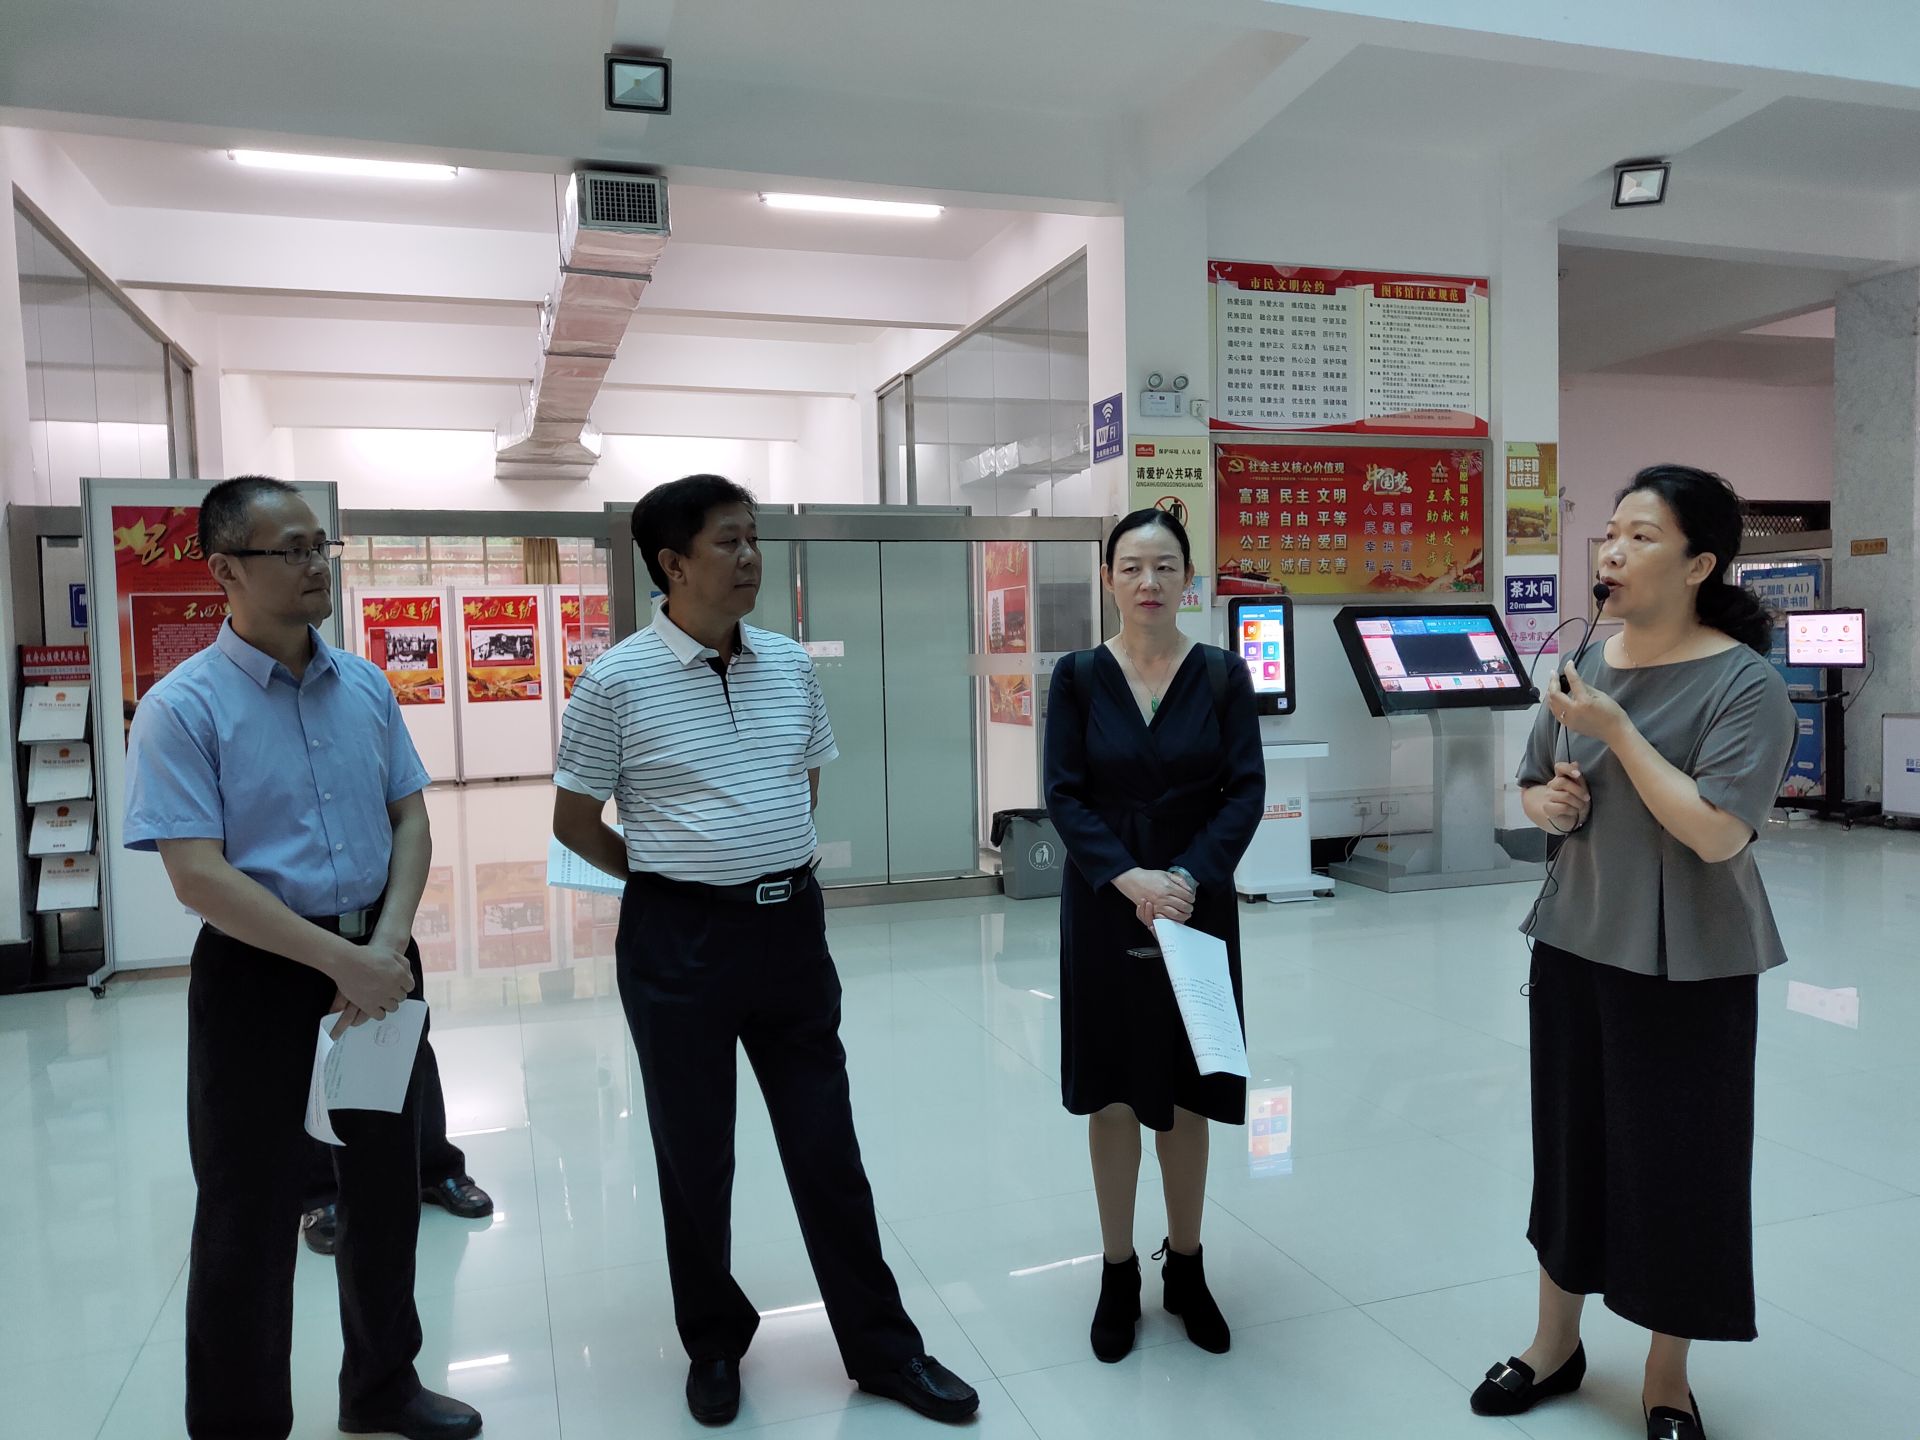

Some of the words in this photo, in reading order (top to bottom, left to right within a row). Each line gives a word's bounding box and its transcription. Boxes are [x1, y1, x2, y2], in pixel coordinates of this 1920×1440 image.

[1250, 277, 1325, 293] 市民文明公约
[1381, 285, 1459, 301] 图书馆行业规范
[1227, 312, 1253, 320] 民族团结
[1136, 466, 1203, 480] 请爱护公共环境
[1248, 460, 1345, 474] 社会主义核心价值观
[1239, 488, 1269, 504] 富强
[1280, 489, 1309, 504] 民主
[1317, 488, 1347, 504] 文明
[1240, 511, 1269, 526] 和谐
[1281, 511, 1308, 527] 自由
[1317, 511, 1347, 527] 平等
[1240, 534, 1270, 550] 公正
[1281, 534, 1311, 550] 法治
[1318, 534, 1347, 550] 爱国
[1240, 558, 1270, 574] 敬业
[1281, 558, 1311, 574] 诚信
[1318, 558, 1347, 574] 友善
[1510, 581, 1553, 599] 茶水间
[1509, 601, 1526, 611] 20m
